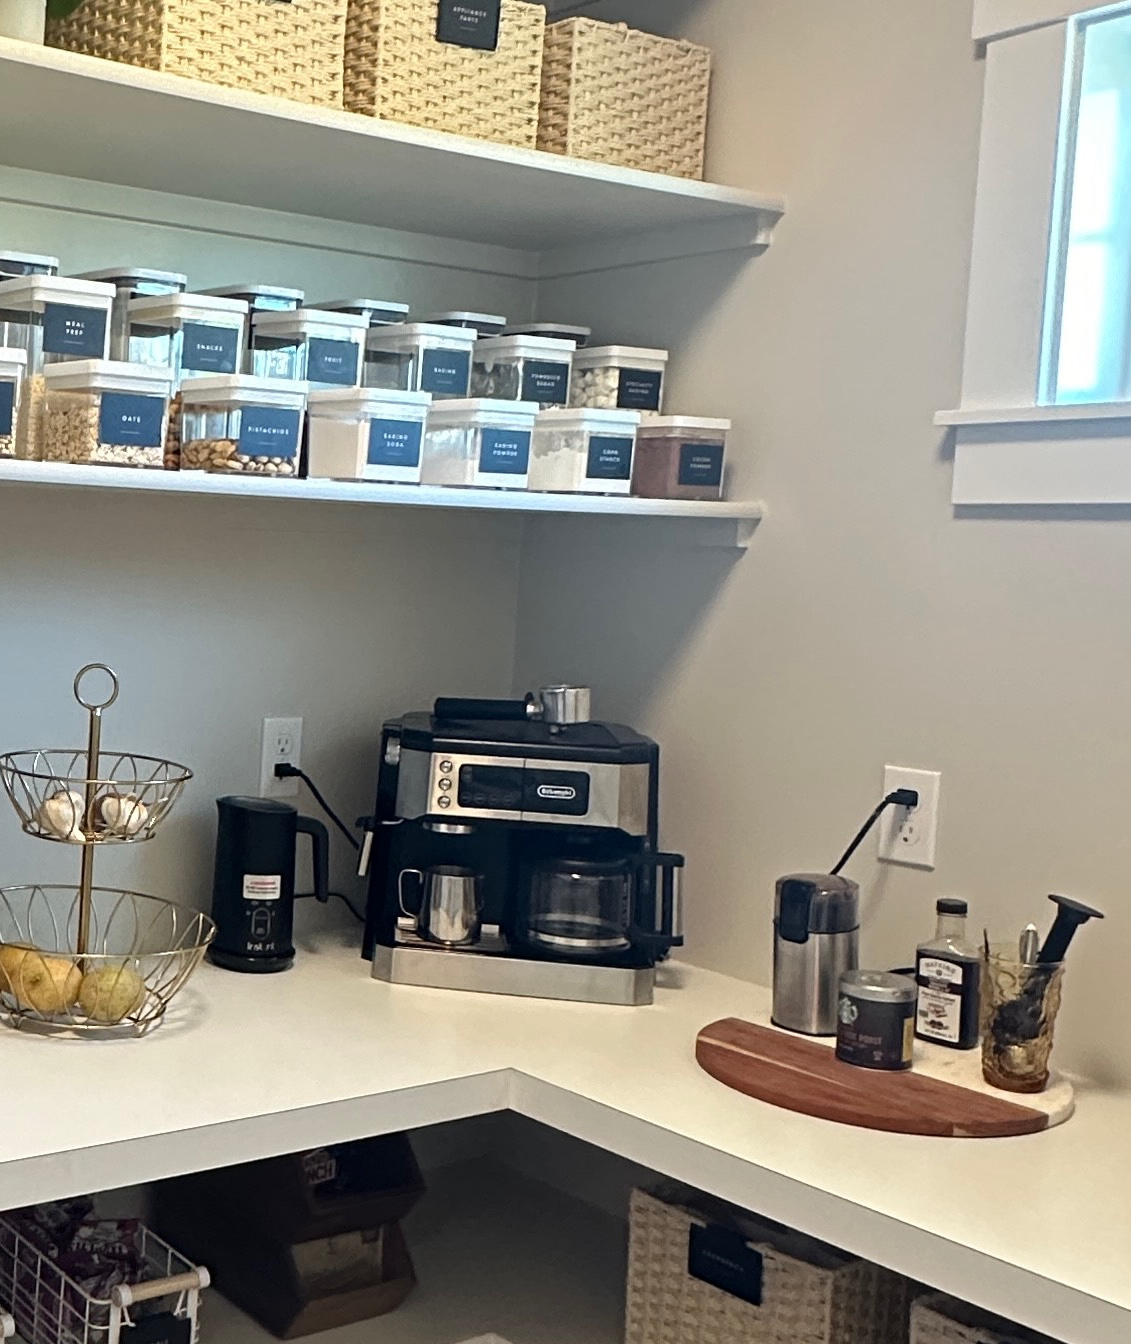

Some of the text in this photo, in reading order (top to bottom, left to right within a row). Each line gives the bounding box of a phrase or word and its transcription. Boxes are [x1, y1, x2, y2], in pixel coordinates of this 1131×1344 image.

[65, 320, 85, 329] MEAL
[65, 328, 84, 336] PREP
[196, 343, 223, 352] SNACKS
[121, 414, 141, 424] OATS
[246, 941, 275, 951] Instnt
